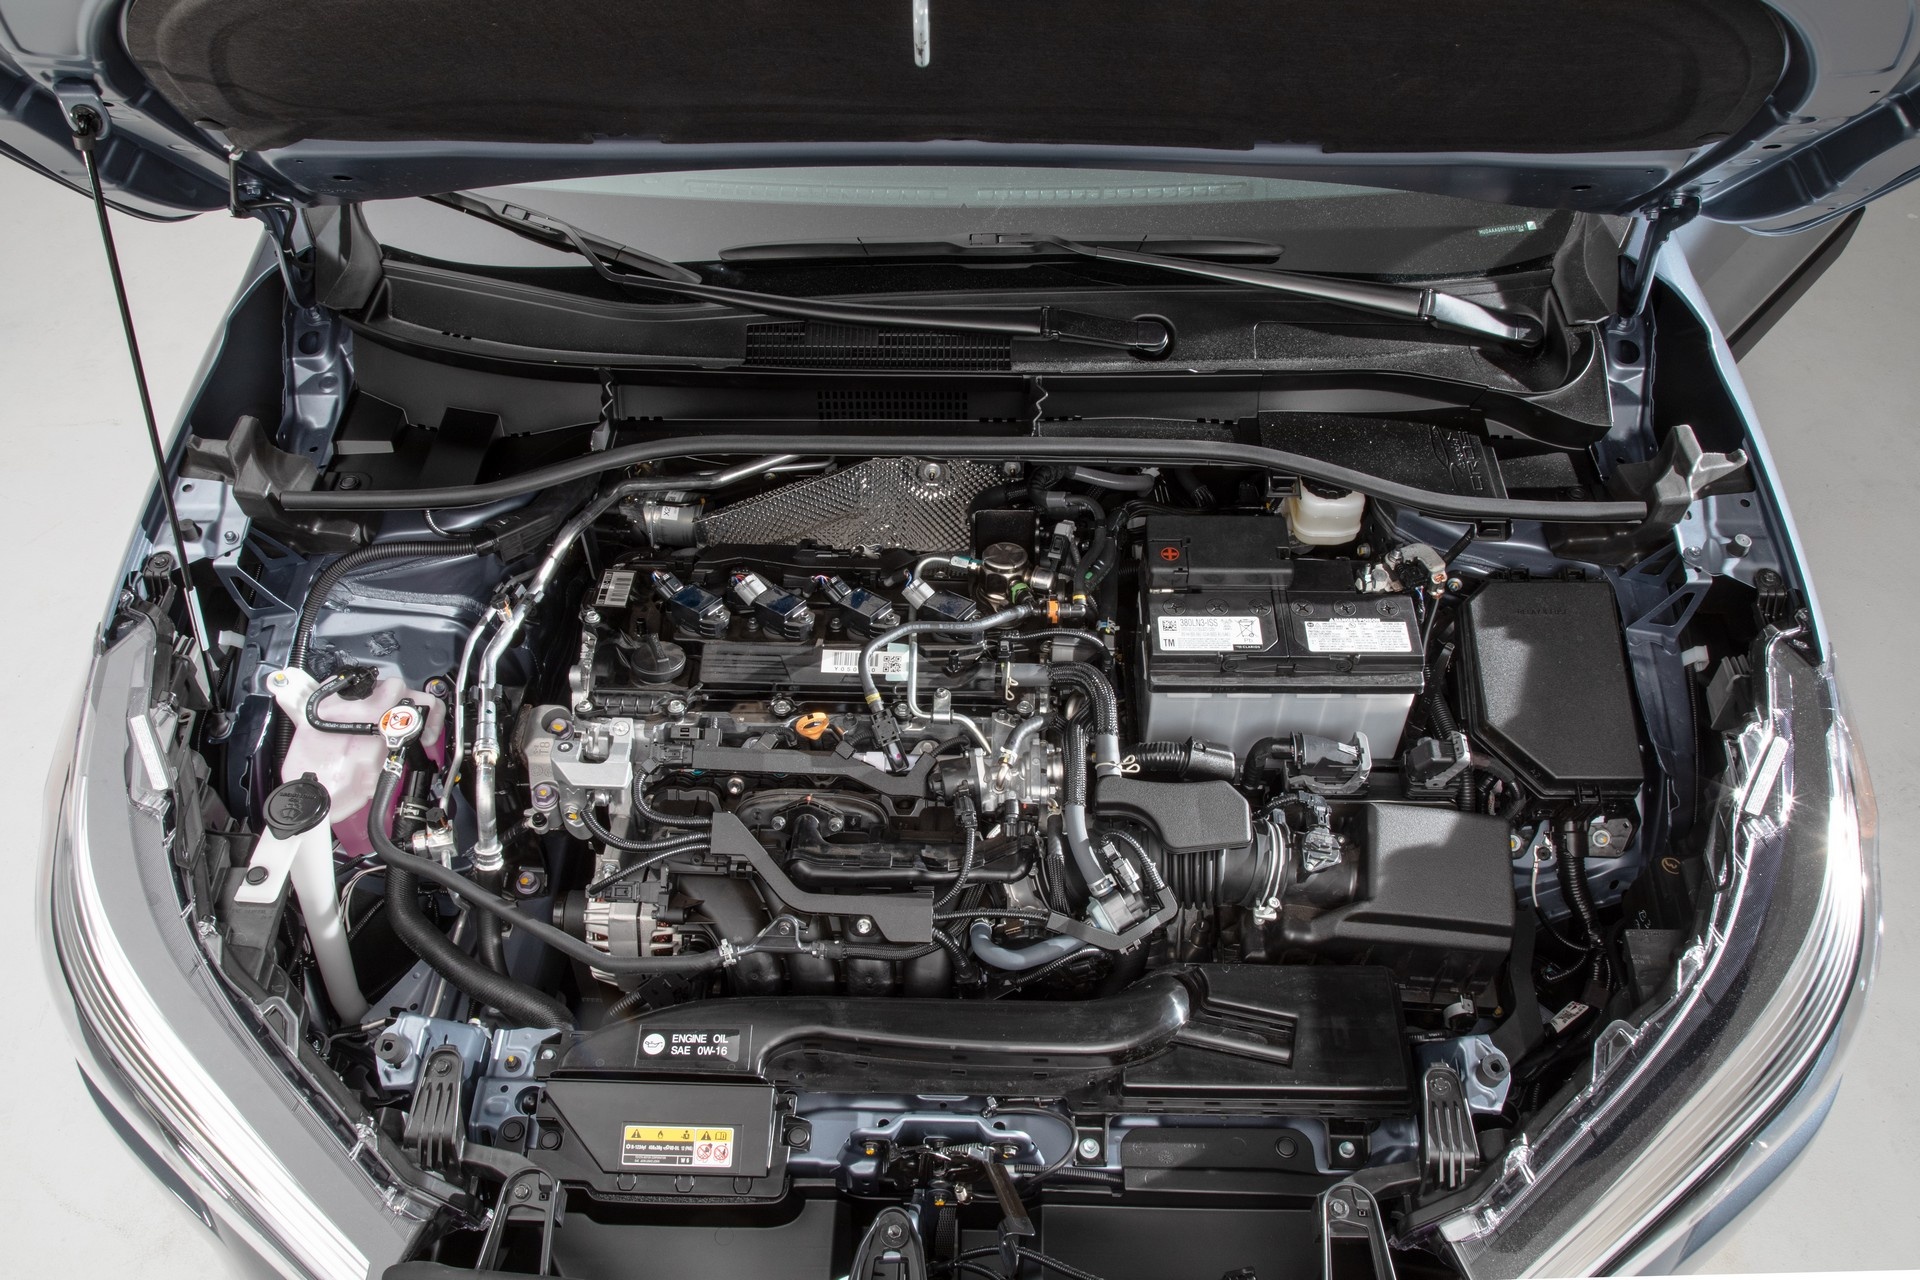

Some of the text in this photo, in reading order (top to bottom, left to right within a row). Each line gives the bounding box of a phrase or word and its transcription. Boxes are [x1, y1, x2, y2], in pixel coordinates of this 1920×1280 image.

[1163, 638, 1175, 647] TM
[671, 1033, 729, 1044] ENGINE OIL
[670, 1045, 728, 1056] SAE 0W-16
